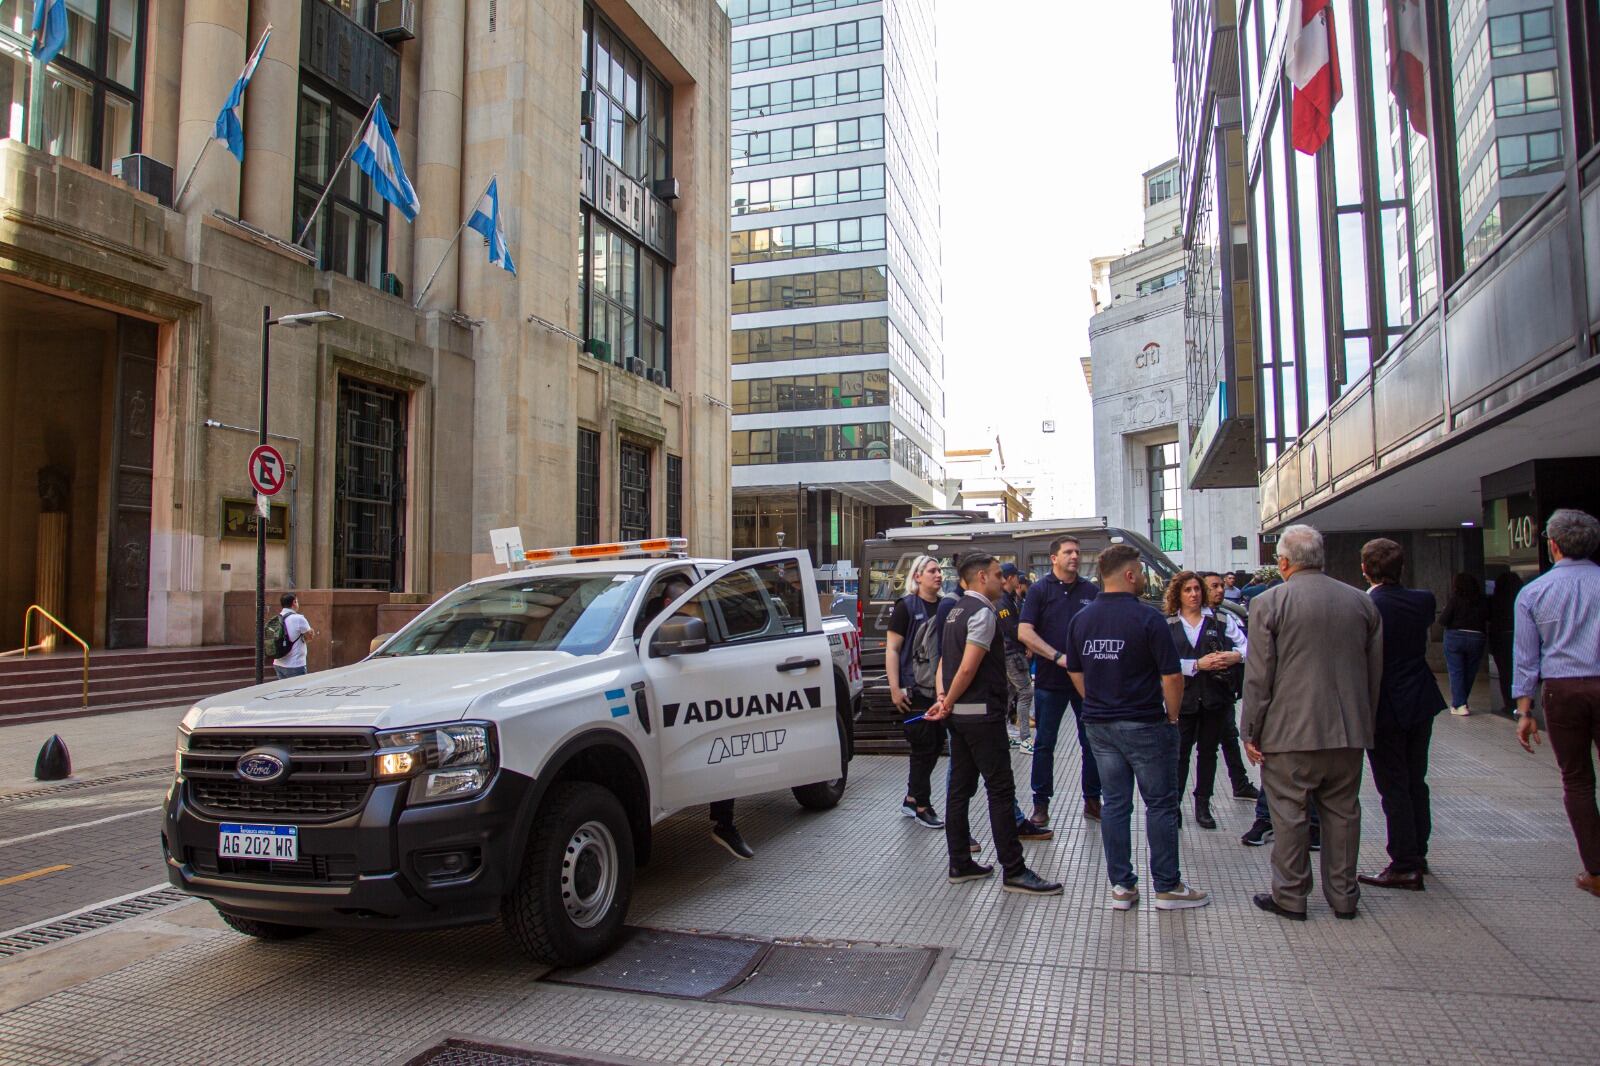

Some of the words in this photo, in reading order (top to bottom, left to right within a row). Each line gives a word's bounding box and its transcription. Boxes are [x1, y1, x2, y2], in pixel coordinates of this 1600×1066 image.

[1135, 342, 1160, 369] citi
[260, 455, 275, 485] E
[1507, 515, 1532, 550] 140
[1082, 639, 1125, 655] AFIP
[683, 690, 804, 725] ADUANA
[707, 729, 786, 764] AFIP
[246, 759, 272, 775] Ford
[223, 835, 240, 853] AG
[245, 836, 270, 855] 202
[276, 838, 293, 857] WR
